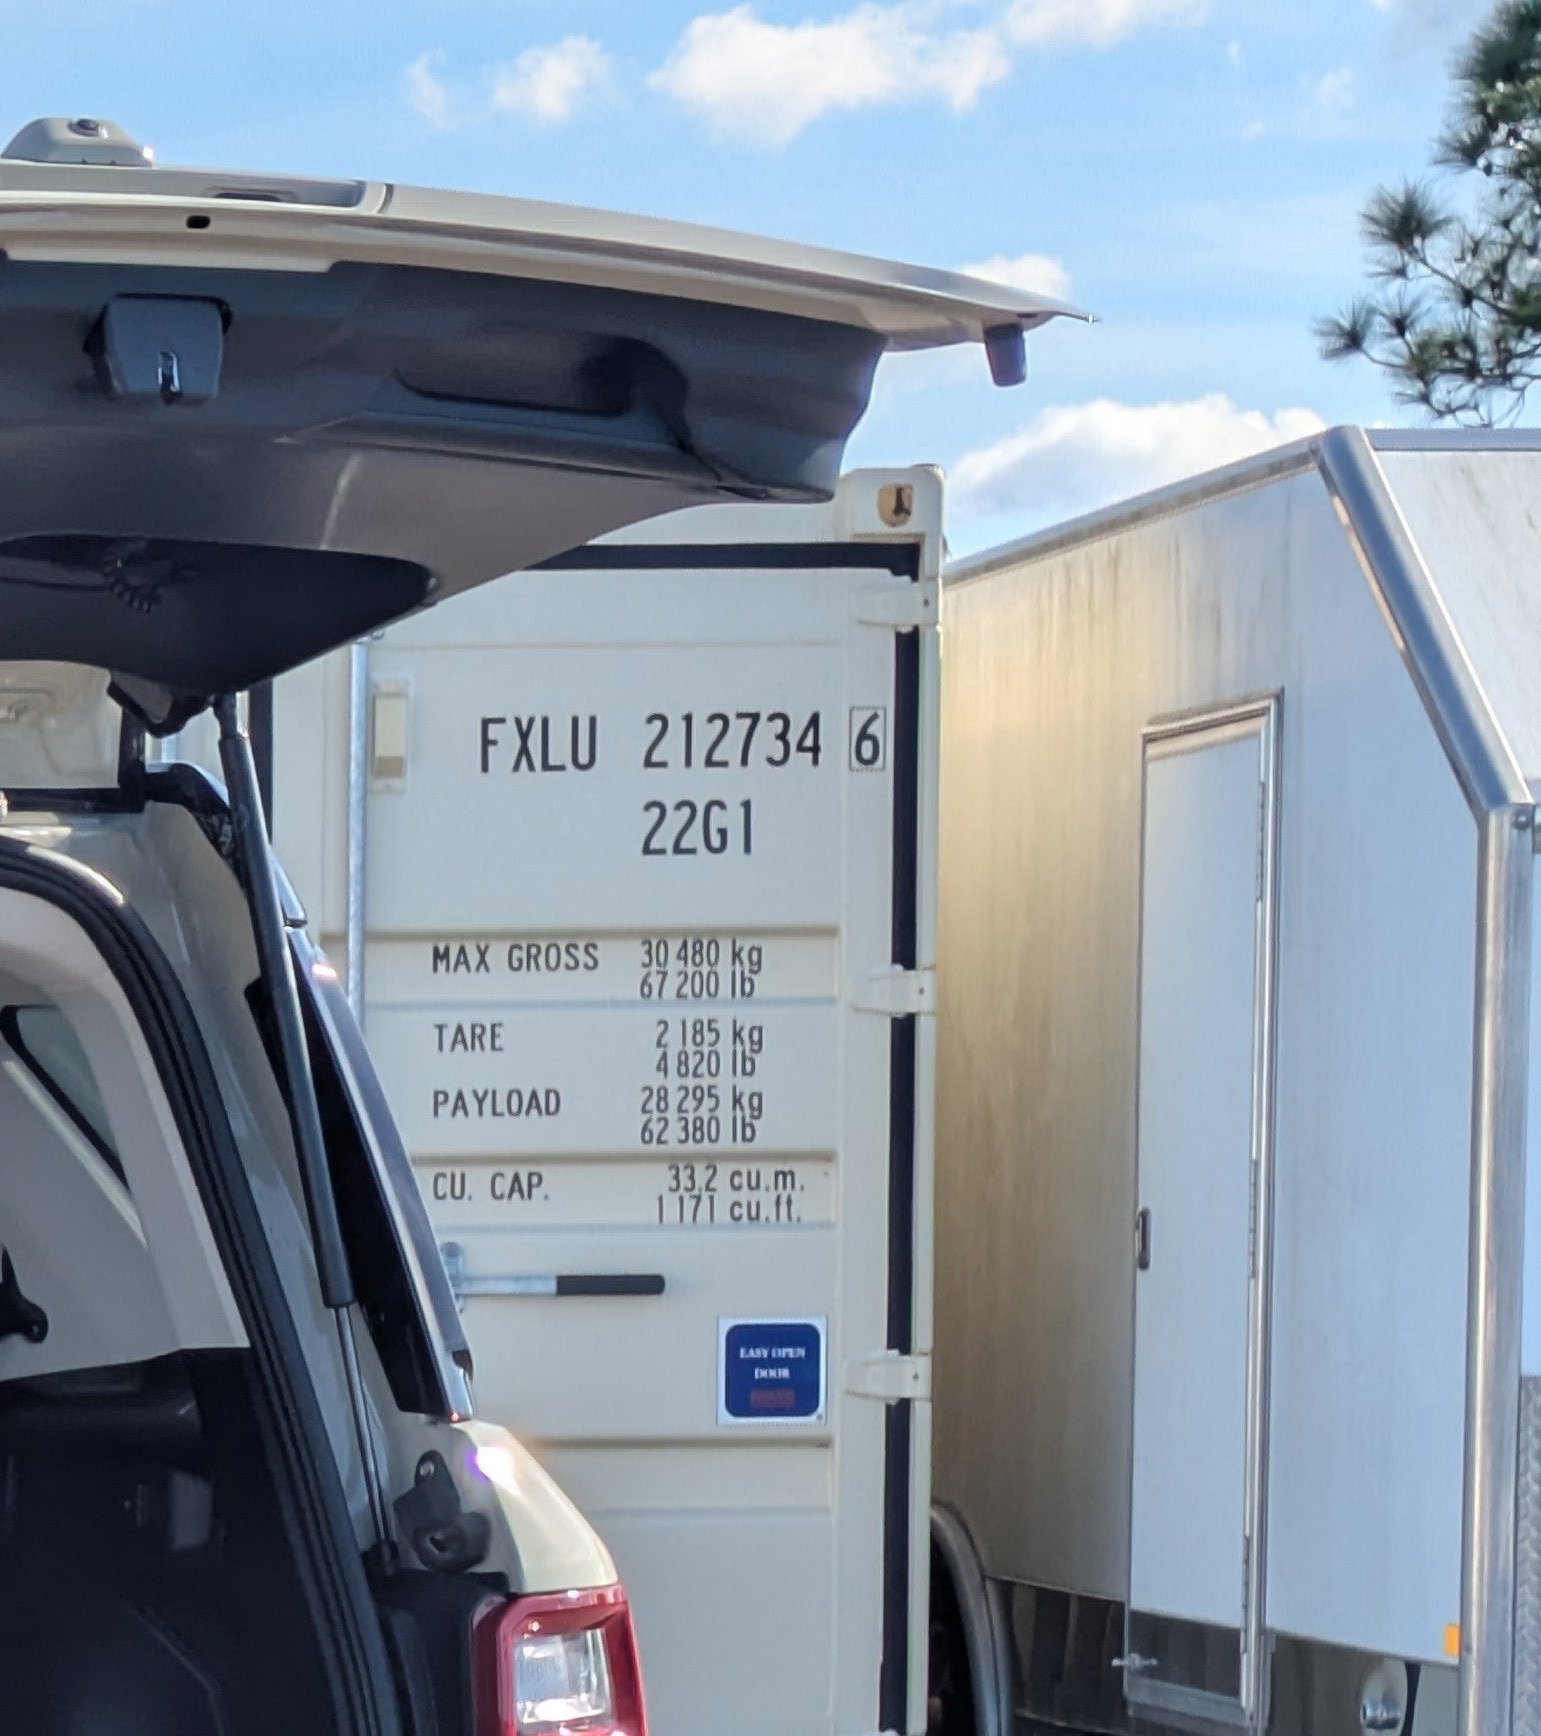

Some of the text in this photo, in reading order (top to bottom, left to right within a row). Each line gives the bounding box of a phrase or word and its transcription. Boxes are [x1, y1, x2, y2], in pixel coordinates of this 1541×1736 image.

[480, 711, 881, 773] FXLU 212734 6
[641, 799, 753, 856] 22G1
[432, 938, 764, 975] MAX GROSS 30 480 kg
[639, 968, 756, 1000] 67 200 lb
[433, 1022, 505, 1053] TARE
[731, 1018, 764, 1054] kg
[731, 1048, 757, 1078] lb
[432, 1085, 764, 1121] PAYLOAD 28 295 kg
[640, 1114, 757, 1145] 62 380 lb
[432, 1171, 473, 1202] CU.
[490, 1171, 550, 1202] CAP.
[729, 1167, 806, 1193] cu.m.
[729, 1194, 802, 1223] cu.ft.
